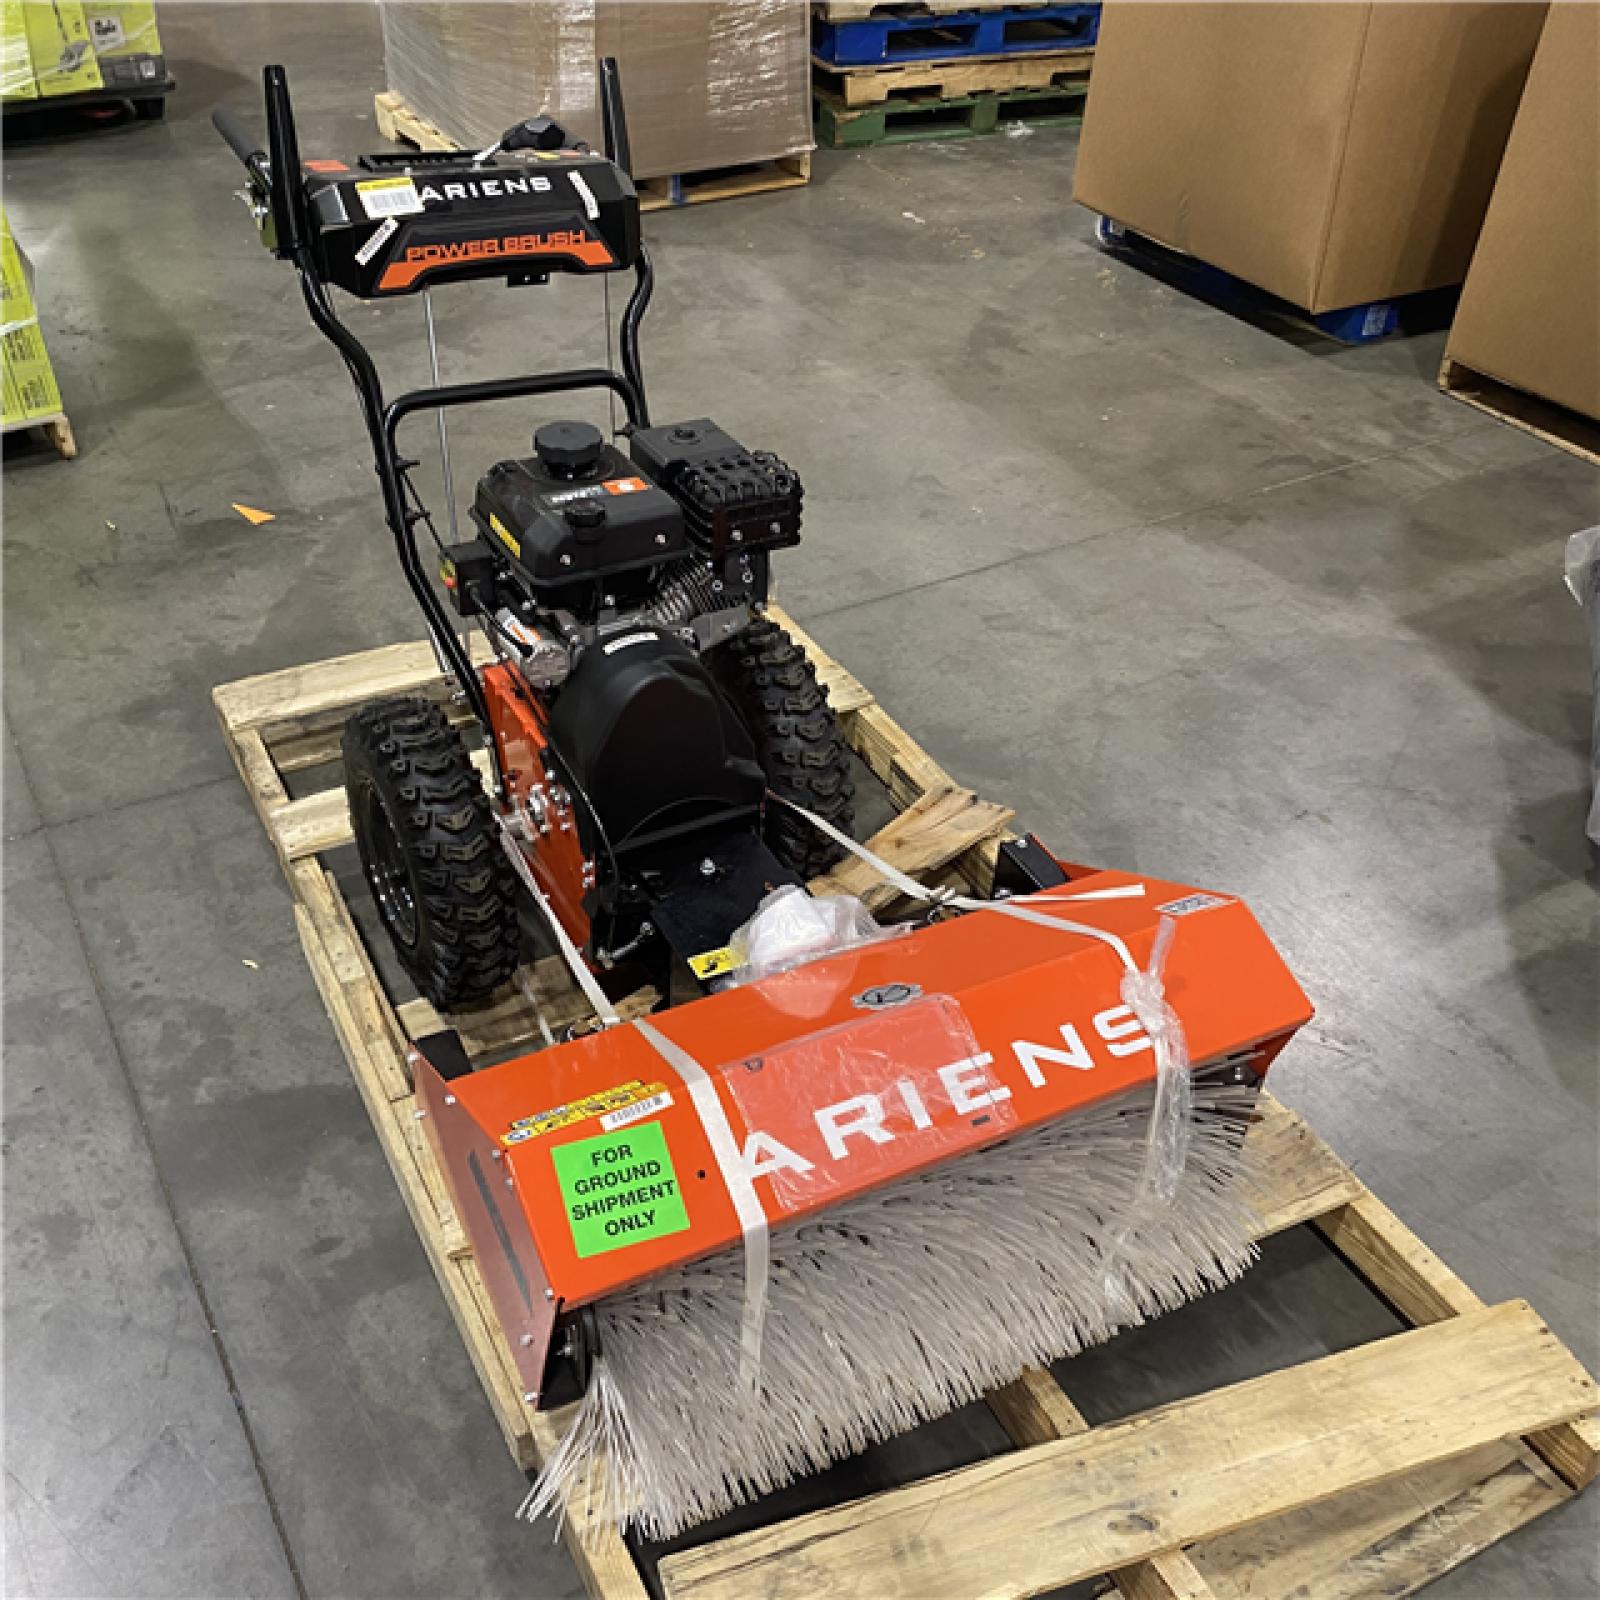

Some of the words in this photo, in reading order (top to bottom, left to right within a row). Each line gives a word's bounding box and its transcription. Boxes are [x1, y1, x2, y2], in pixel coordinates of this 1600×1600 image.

[422, 176, 552, 201] ARIENS
[407, 239, 499, 262] POWER
[504, 230, 586, 252] BRUSH
[741, 1004, 1156, 1180] ARIENS
[591, 1144, 633, 1168] FOR
[574, 1160, 661, 1195] GROUND
[572, 1179, 674, 1221] SHIPMENT
[604, 1209, 656, 1236] ONLY
